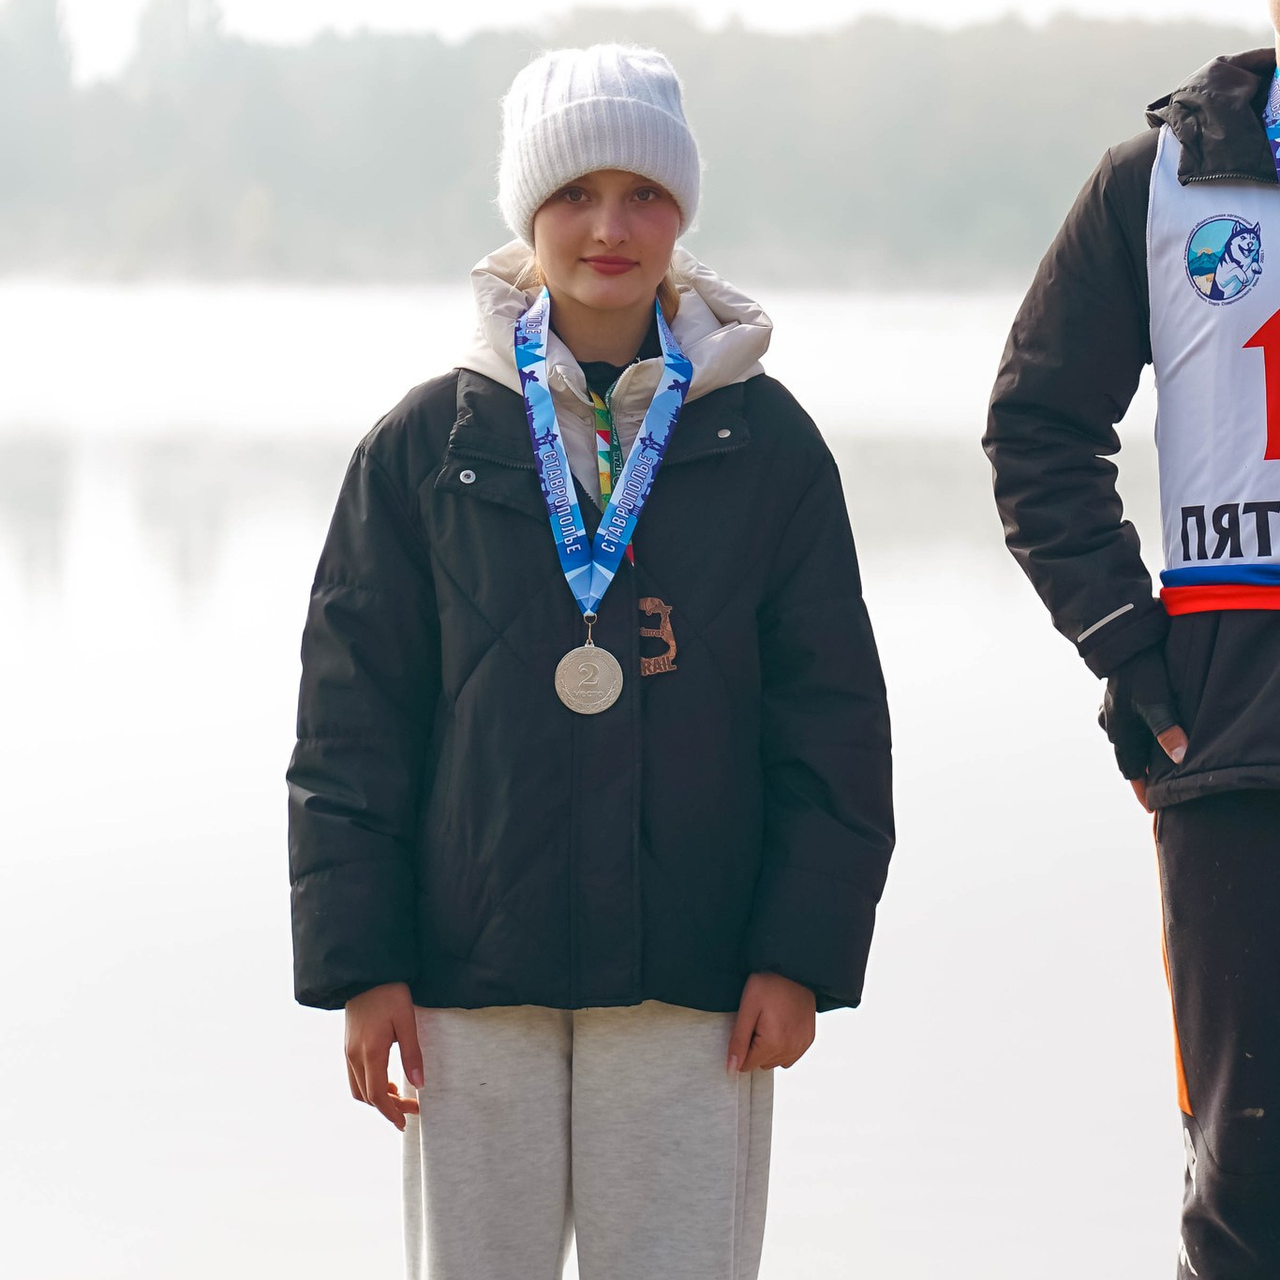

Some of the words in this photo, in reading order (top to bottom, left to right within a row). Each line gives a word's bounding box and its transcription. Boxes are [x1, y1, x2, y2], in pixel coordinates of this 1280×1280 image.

[542, 450, 582, 554] СТАВРОПОЛЬЕ
[601, 453, 653, 553] СТАВРОПОЛЬЕ
[578, 662, 600, 687] 2
